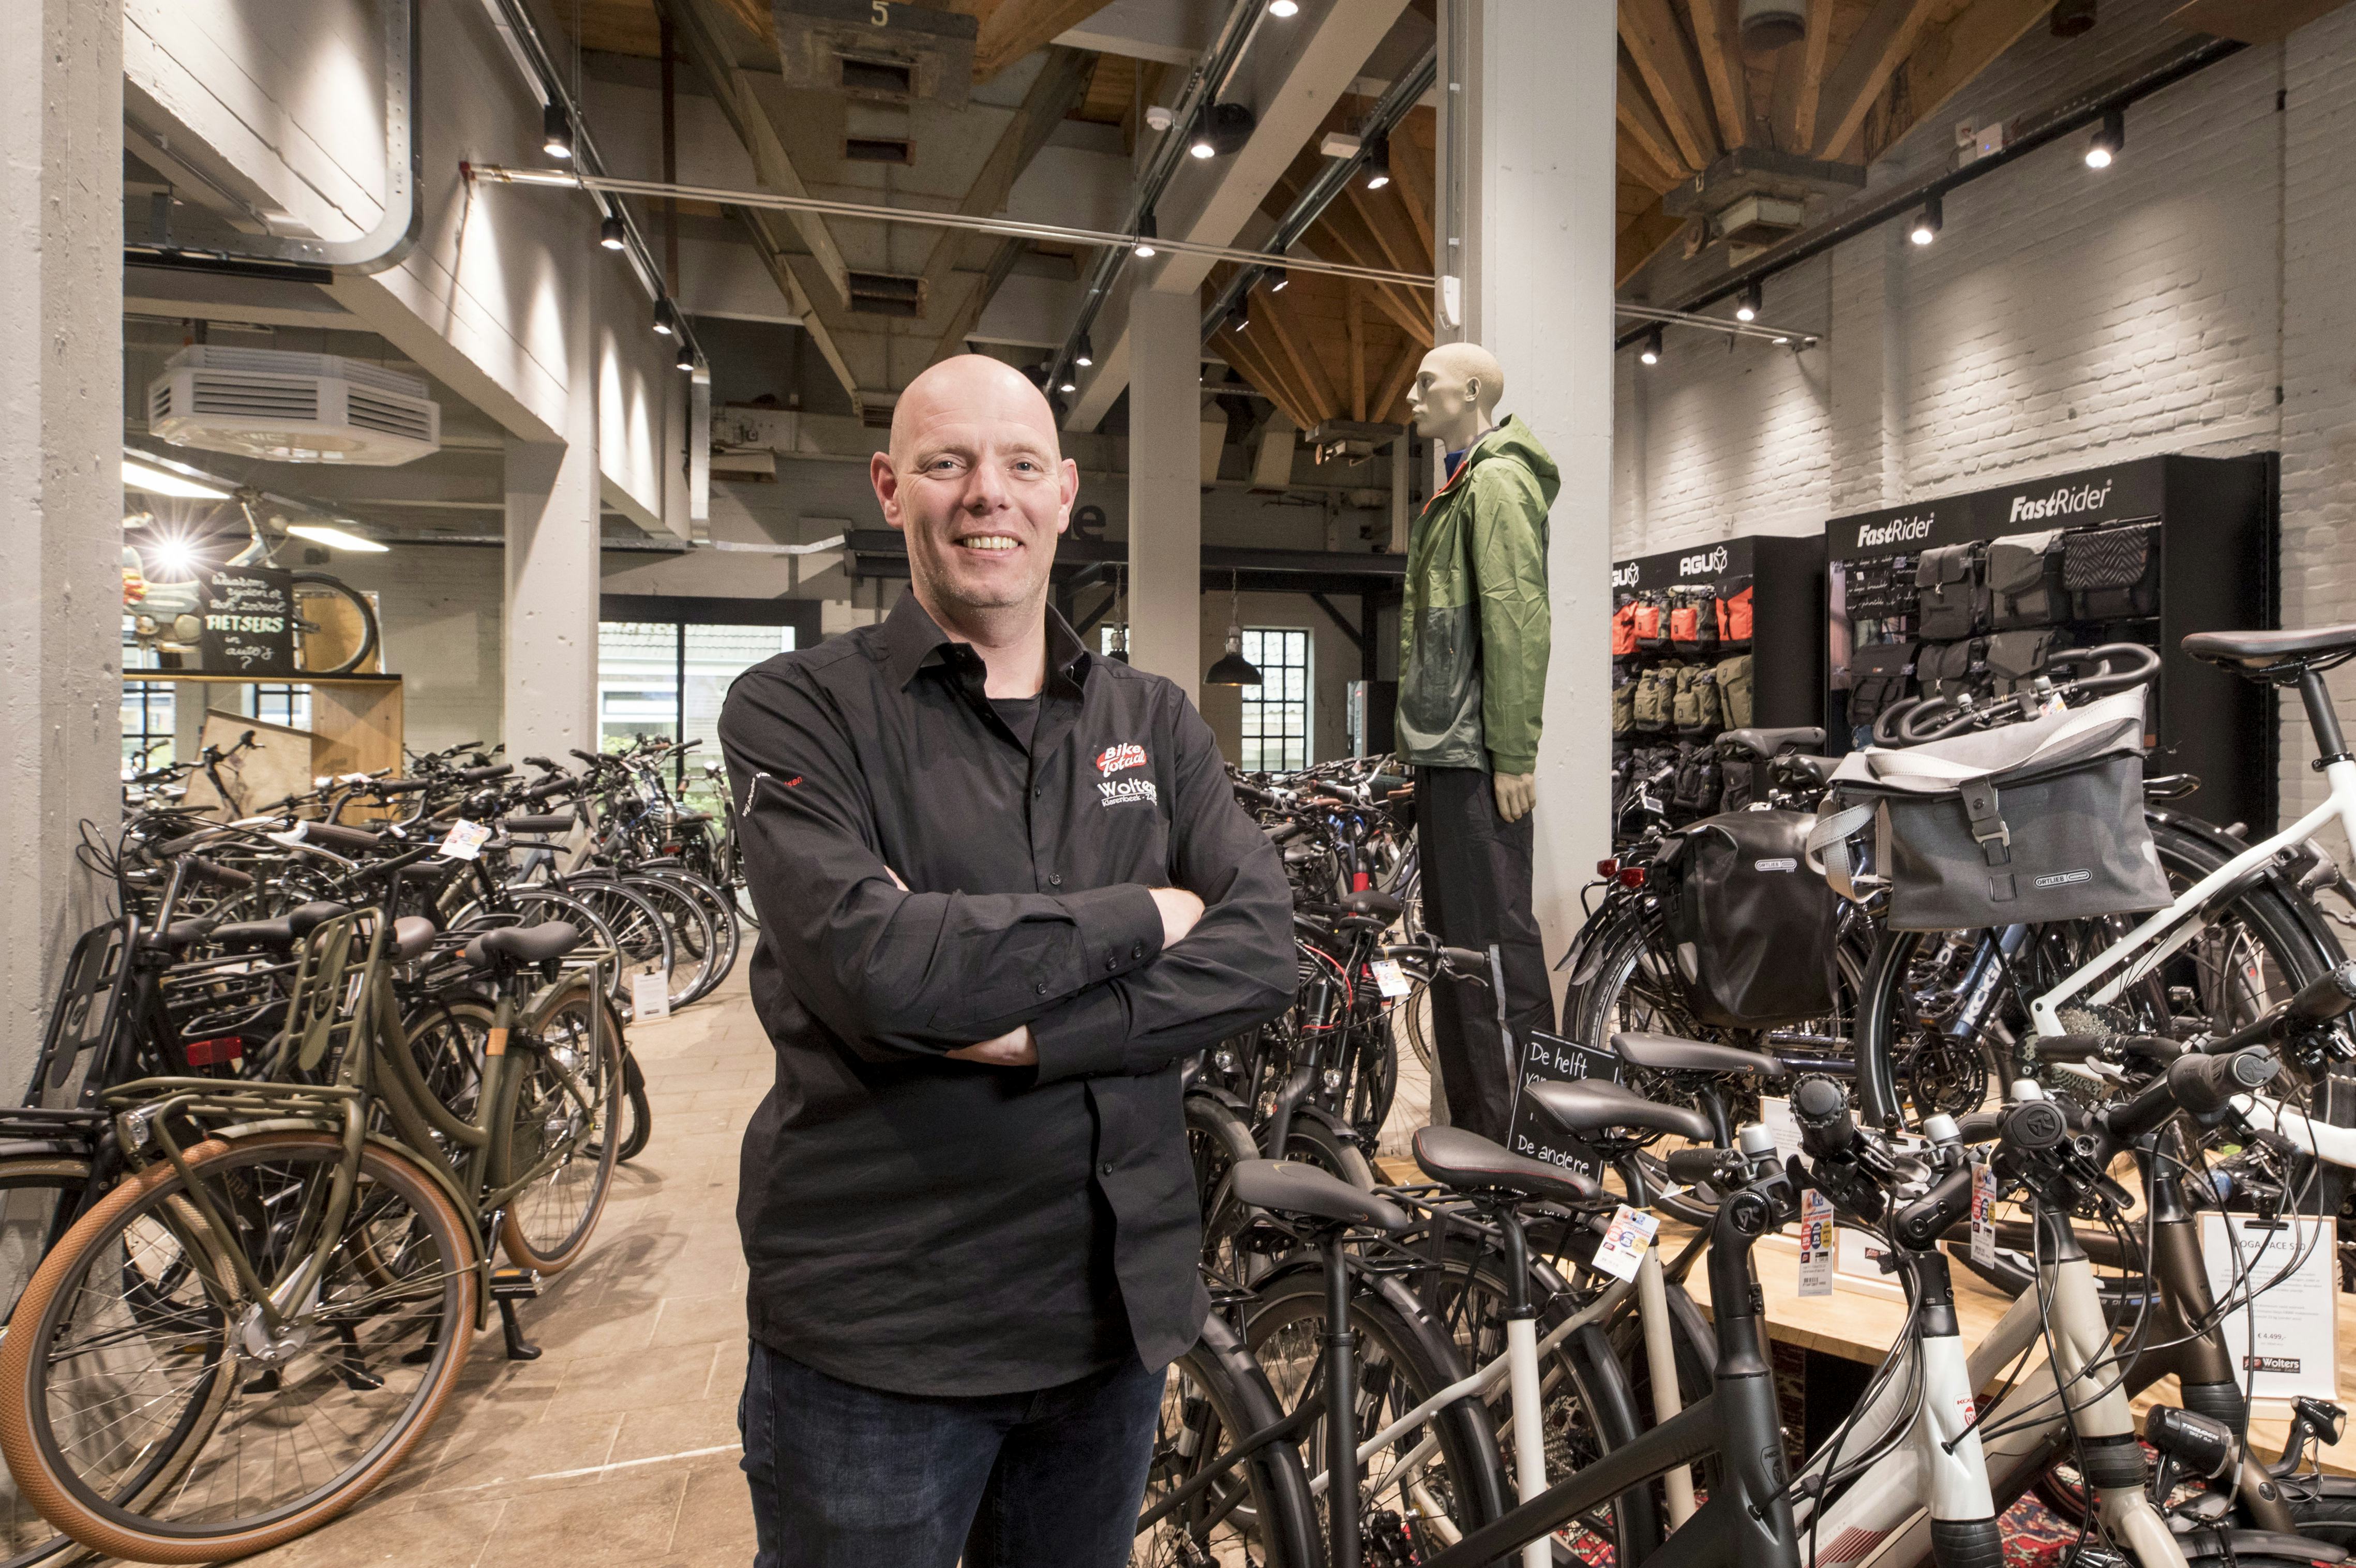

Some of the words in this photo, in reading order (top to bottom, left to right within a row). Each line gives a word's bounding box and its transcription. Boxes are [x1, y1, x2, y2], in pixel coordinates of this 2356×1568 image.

[871, 1, 889, 26] 5
[2009, 484, 2112, 522] FastRider
[1857, 515, 1934, 547] FastRider
[1680, 553, 1713, 576] AGU
[1612, 568, 1628, 587] GU
[204, 614, 285, 633] FIETSERS
[1105, 743, 1142, 760] Bike
[1100, 749, 1146, 778] Totaal
[2037, 876, 2064, 885] ORTLIEB
[1529, 1042, 1550, 1065] De
[1554, 1047, 1588, 1080] helft
[1518, 1134, 1535, 1155] De
[1538, 1145, 1589, 1177] andere
[2237, 1240, 2261, 1248] OGA
[2267, 1241, 2287, 1249] ACE
[2262, 1358, 2300, 1368] Wolters
[2183, 1422, 2219, 1441] TRELOCK
